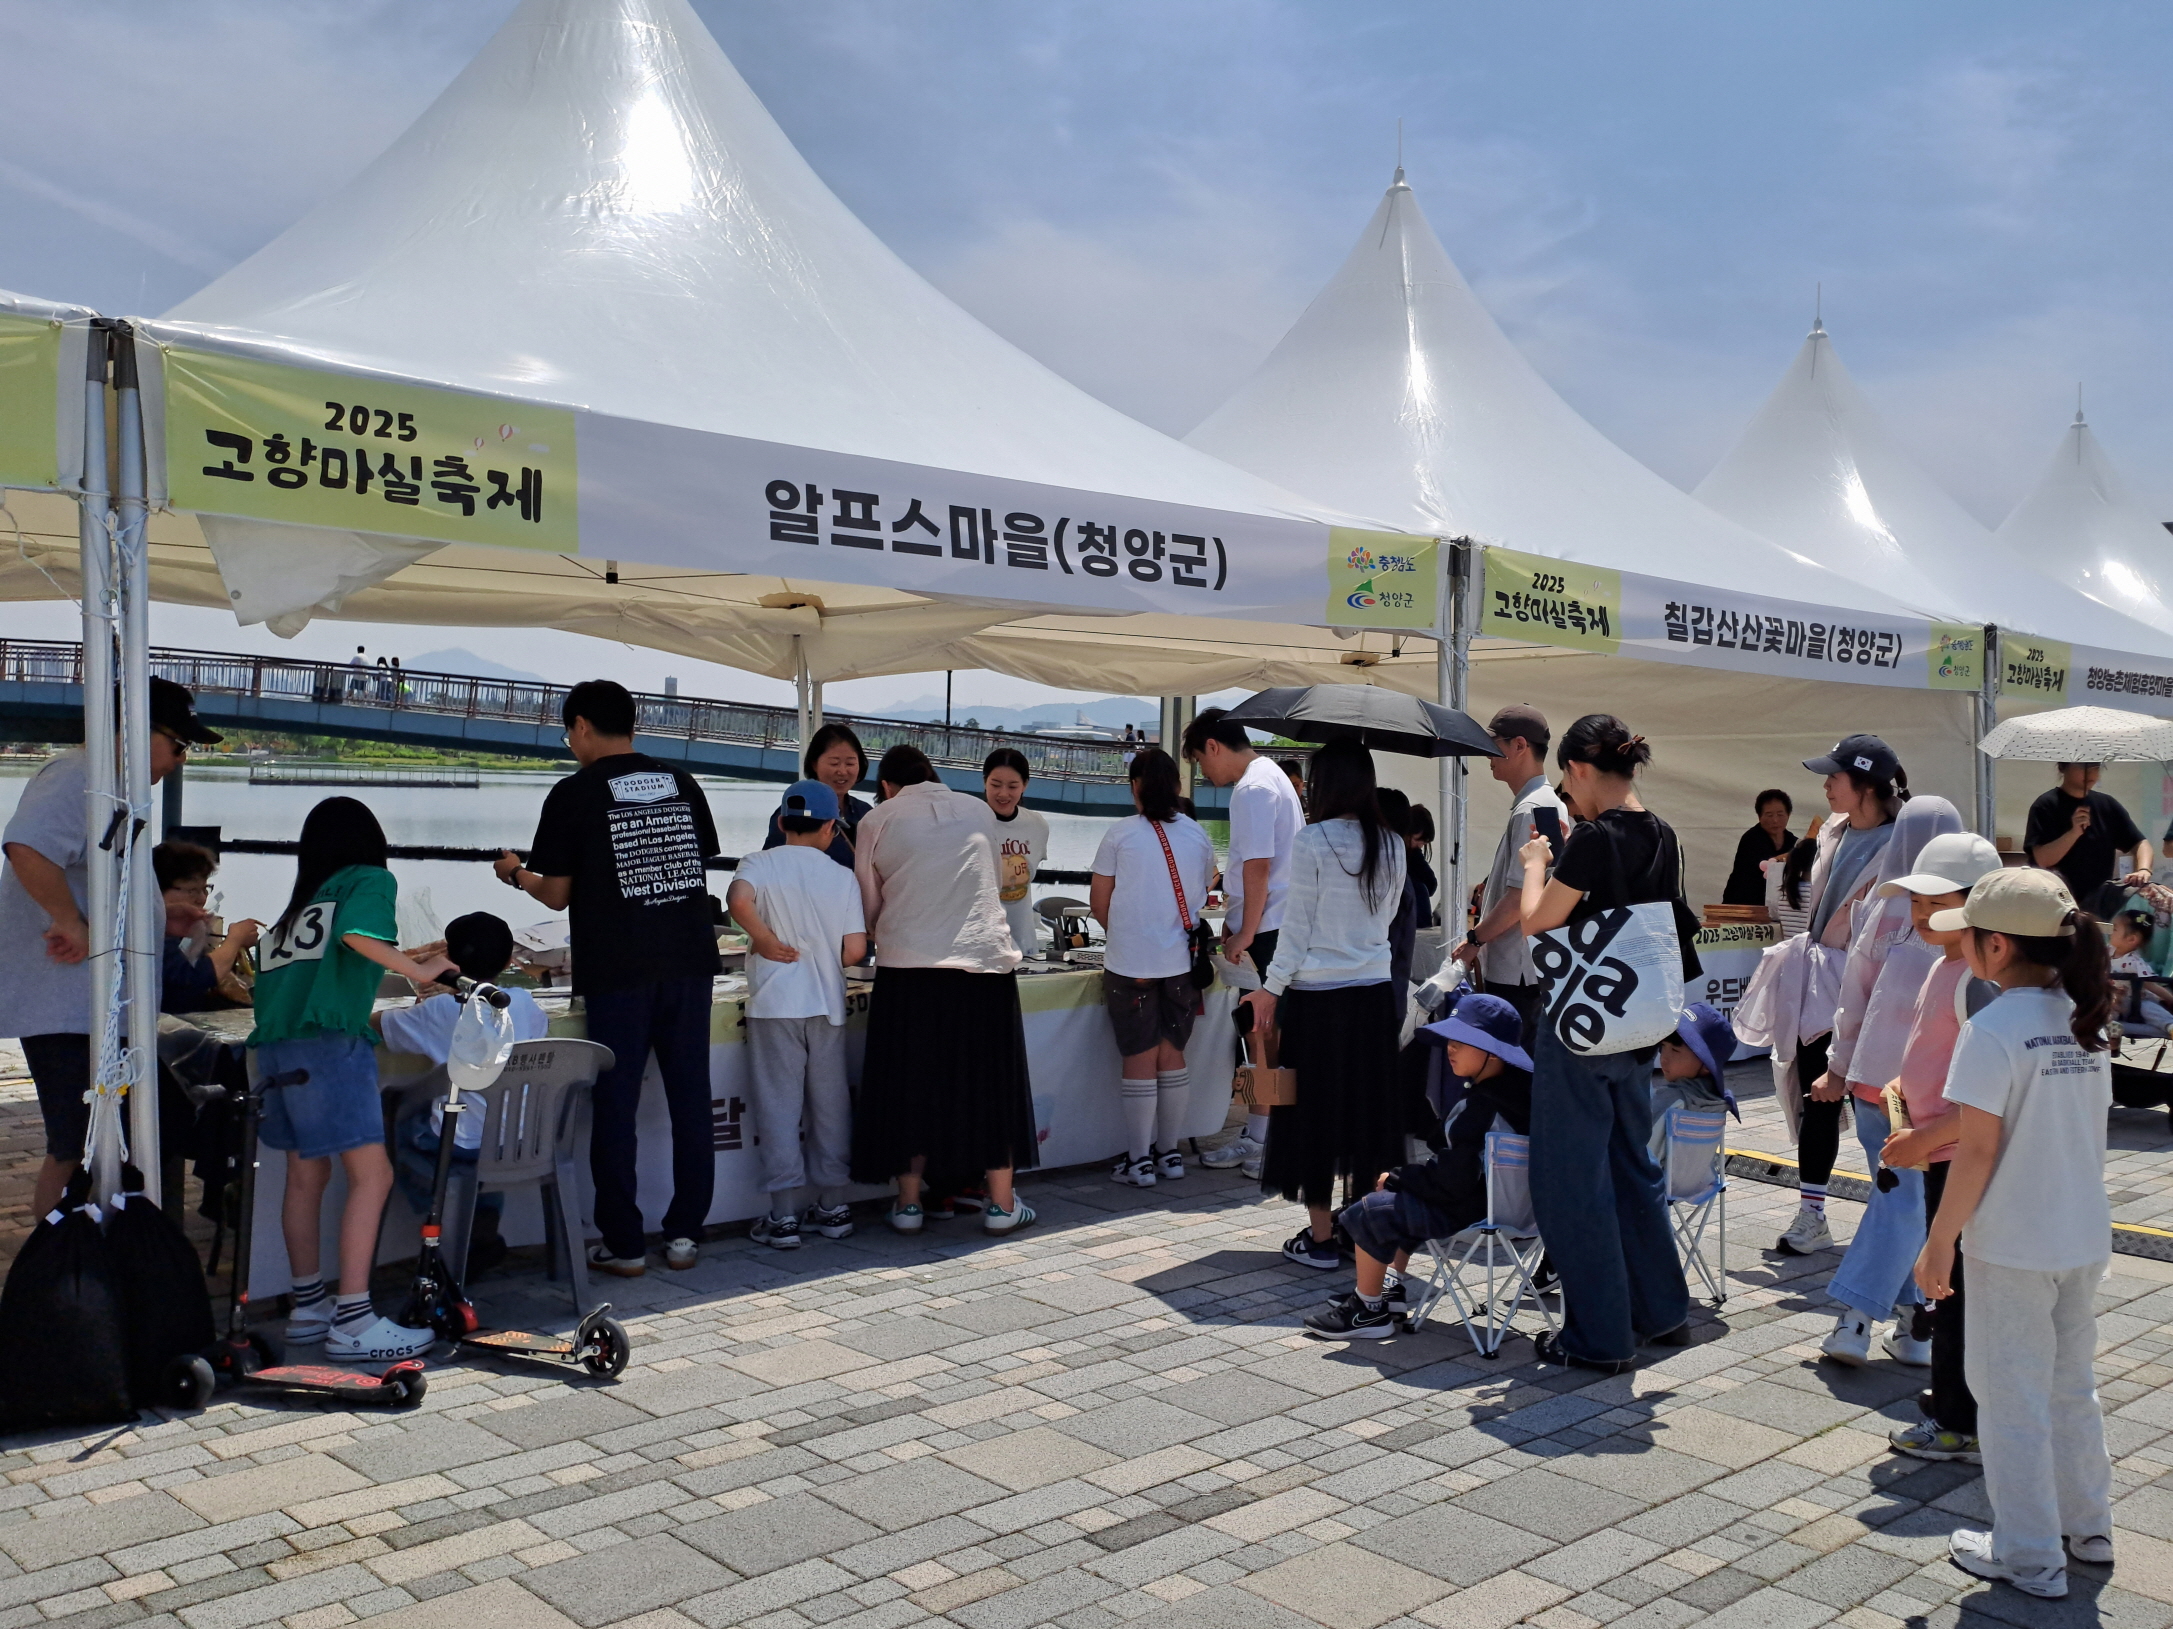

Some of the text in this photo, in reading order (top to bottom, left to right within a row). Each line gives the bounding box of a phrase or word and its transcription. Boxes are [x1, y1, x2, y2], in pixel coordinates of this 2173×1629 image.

[324, 401, 417, 442] 2025
[202, 428, 543, 524] 고향마실축제
[765, 477, 1227, 592] 알프스마을(청양군)
[1531, 572, 1565, 594] 2025
[1378, 591, 1415, 609] 청양군
[1493, 590, 1610, 637] 고향마실축제
[1664, 601, 1903, 669] 칠갑산산꽃마을(청양군)
[2026, 648, 2045, 663] 2025
[2006, 663, 2065, 693] 고향마실축제
[623, 777, 661, 787] DODGER
[624, 783, 665, 793] STADIUM
[607, 813, 621, 821] The
[621, 810, 633, 818] LOS
[633, 807, 662, 817] ANGELES
[610, 821, 628, 832] are
[630, 819, 643, 828] an
[651, 824, 680, 834] baseball
[612, 840, 639, 850] based
[639, 838, 648, 846] in
[647, 836, 663, 845] Los
[614, 853, 629, 861] The
[629, 847, 663, 858] DODGERS
[616, 858, 642, 869] MAJOR
[642, 855, 667, 864] LEAGUE
[663, 861, 682, 870] Club
[619, 867, 703, 887] NATIONAL LEAGUE
[620, 877, 705, 899] West Division.
[1695, 925, 1775, 945] 2025 고향마실축제
[369, 1344, 414, 1359] crocs
